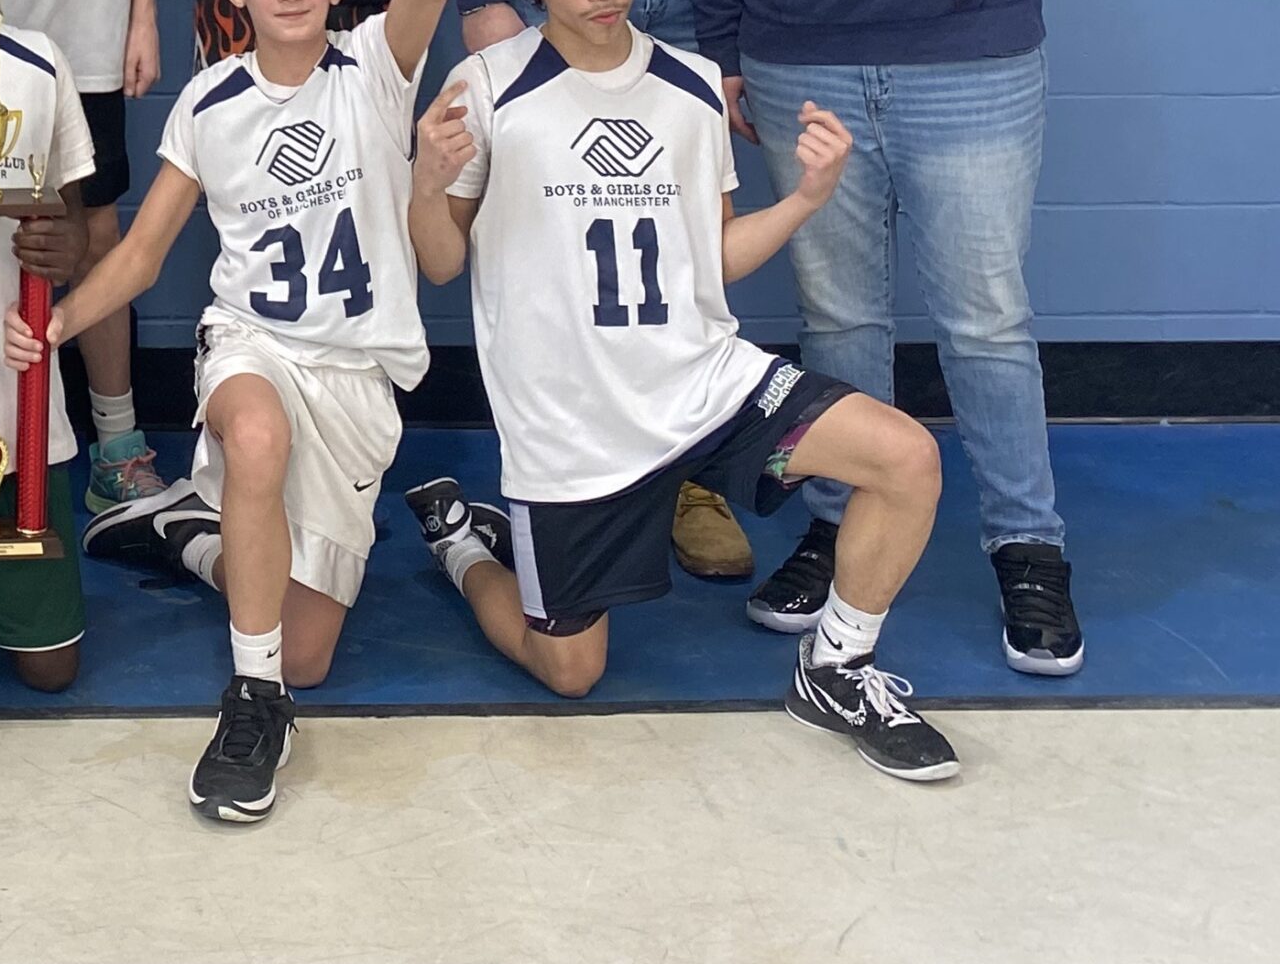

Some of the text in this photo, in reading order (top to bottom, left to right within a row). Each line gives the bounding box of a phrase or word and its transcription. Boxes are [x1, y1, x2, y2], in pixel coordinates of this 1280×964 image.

[240, 197, 278, 214] BOYS
[282, 194, 292, 206] &
[336, 168, 364, 187] CUB
[543, 184, 585, 197] BOYS
[590, 184, 602, 195] &
[607, 184, 652, 195] GIRLS
[573, 197, 670, 207] OF MANCHESTER
[268, 208, 281, 219] OF
[249, 206, 374, 322] 34
[585, 218, 668, 327] 11
